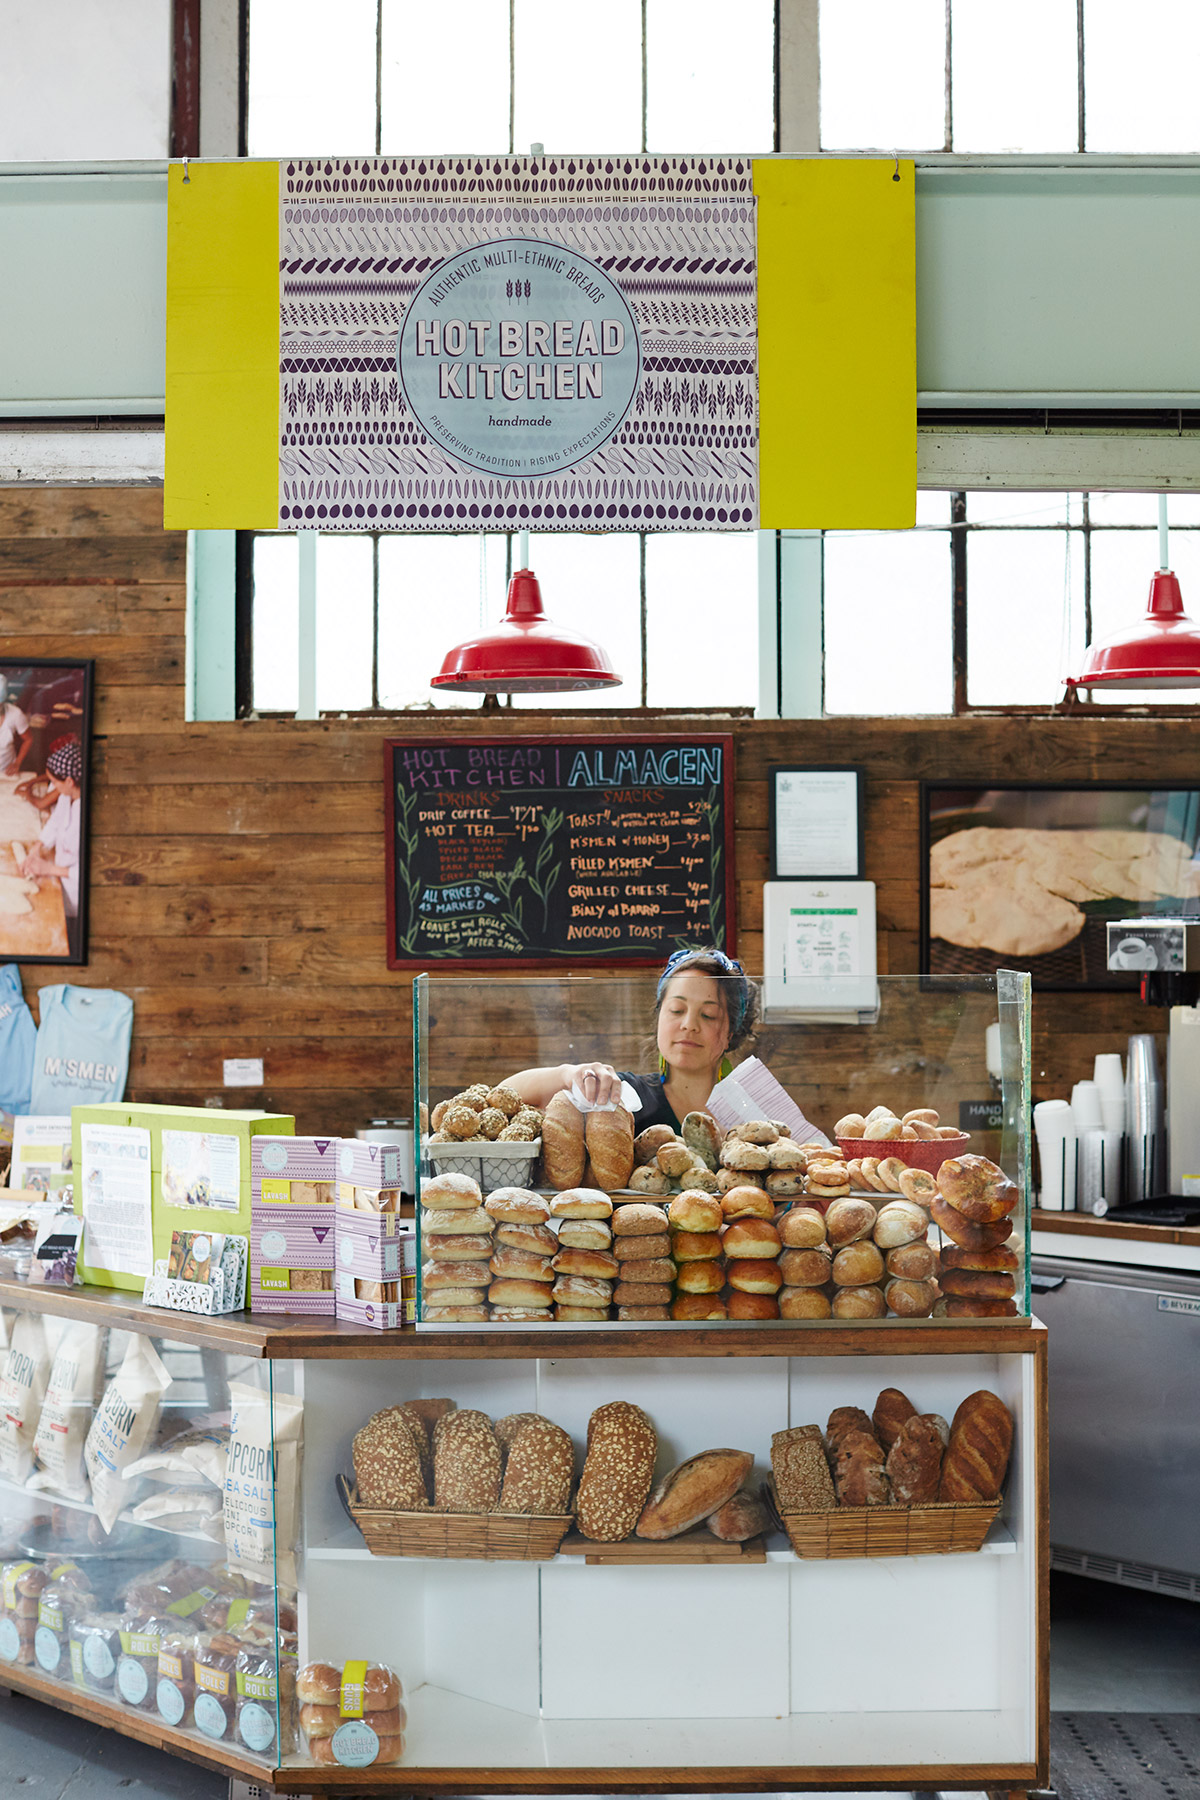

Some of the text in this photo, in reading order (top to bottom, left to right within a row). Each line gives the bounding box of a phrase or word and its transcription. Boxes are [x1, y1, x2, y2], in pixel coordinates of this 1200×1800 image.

[428, 249, 605, 307] AUTHENTIC MULTI-ETHNIC BREADS
[415, 319, 625, 357] HOT BREAD
[438, 362, 603, 400] KITCHEN
[488, 415, 552, 427] handmade
[429, 410, 616, 468] PRESERVING TRADITION RISING EXPECTATIONS
[403, 748, 541, 770] HOT BREAD
[567, 748, 722, 787] ALMACEN
[409, 768, 545, 788] KITCHEN
[437, 790, 501, 808] DRINKS
[603, 788, 665, 804] SNACKS
[419, 810, 446, 821] DRIP
[451, 808, 492, 820] COFFEE
[425, 824, 456, 837] HOT
[463, 824, 495, 837] TEA
[570, 836, 616, 849] M'SMEN
[633, 834, 670, 853] HONEY
[422, 889, 438, 902] ALL
[442, 885, 481, 902] PRICES
[568, 884, 620, 900] GRILLED
[624, 884, 670, 896] CHEESE
[419, 900, 485, 913] AS MARKED
[420, 920, 457, 932] LOAVES
[478, 917, 507, 931] ROLLS
[567, 925, 621, 940] AVOCADO
[628, 924, 665, 939] TOAST
[467, 937, 495, 947] AFTER
[45, 1057, 117, 1084] M'SMEN
[263, 1192, 289, 1200] LAVASH
[262, 1279, 288, 1288] LAVASH
[101, 1421, 127, 1451] SALT
[243, 1484, 278, 1502] SALT
[131, 1641, 159, 1653] ROLLS
[200, 1673, 226, 1691] ROLLS
[245, 1682, 277, 1697] ROLLS
[343, 1683, 354, 1711] BUNS
[334, 1739, 350, 1749] HOT
[338, 1746, 374, 1757] KITCHEN
